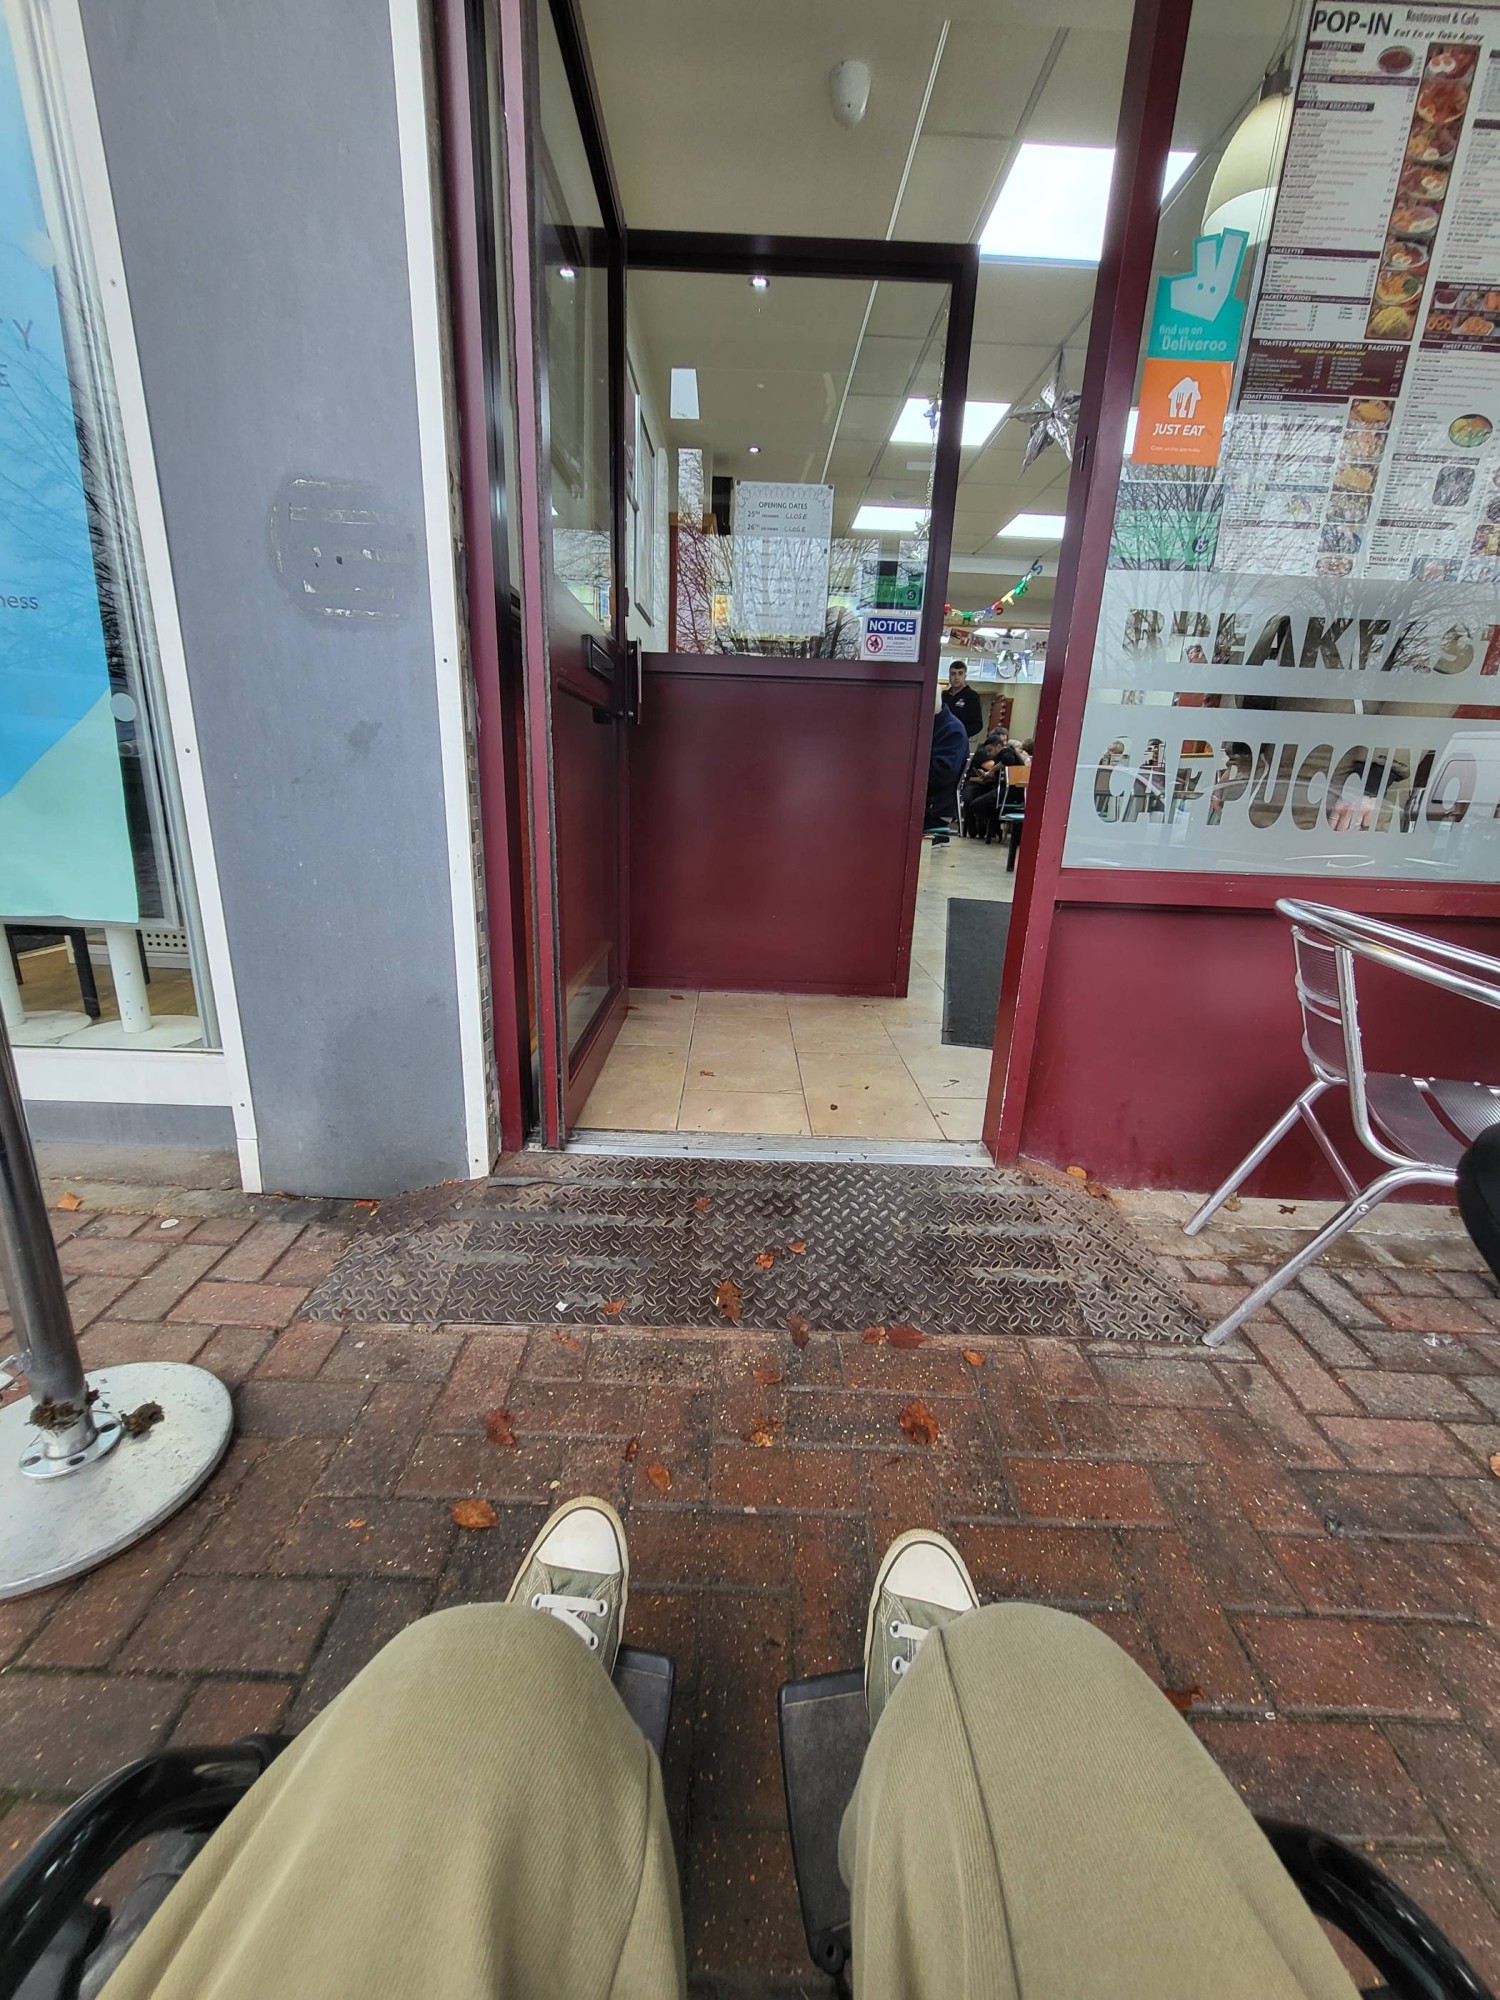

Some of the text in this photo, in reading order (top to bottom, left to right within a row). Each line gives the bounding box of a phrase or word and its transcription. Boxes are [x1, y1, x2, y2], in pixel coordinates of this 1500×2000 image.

[1312, 10, 1393, 36] POP-IN
[1159, 325, 1203, 336] find us on
[1162, 335, 1227, 351] Deliveroo
[1259, 339, 1288, 348] TOASTED
[1288, 341, 1330, 349] SANDWICHES
[1153, 423, 1205, 437] JUST EAT
[758, 501, 808, 510] OPENING DATES
[869, 620, 914, 632] NOTICE
[1094, 736, 1477, 834] CAPPUCCINO
